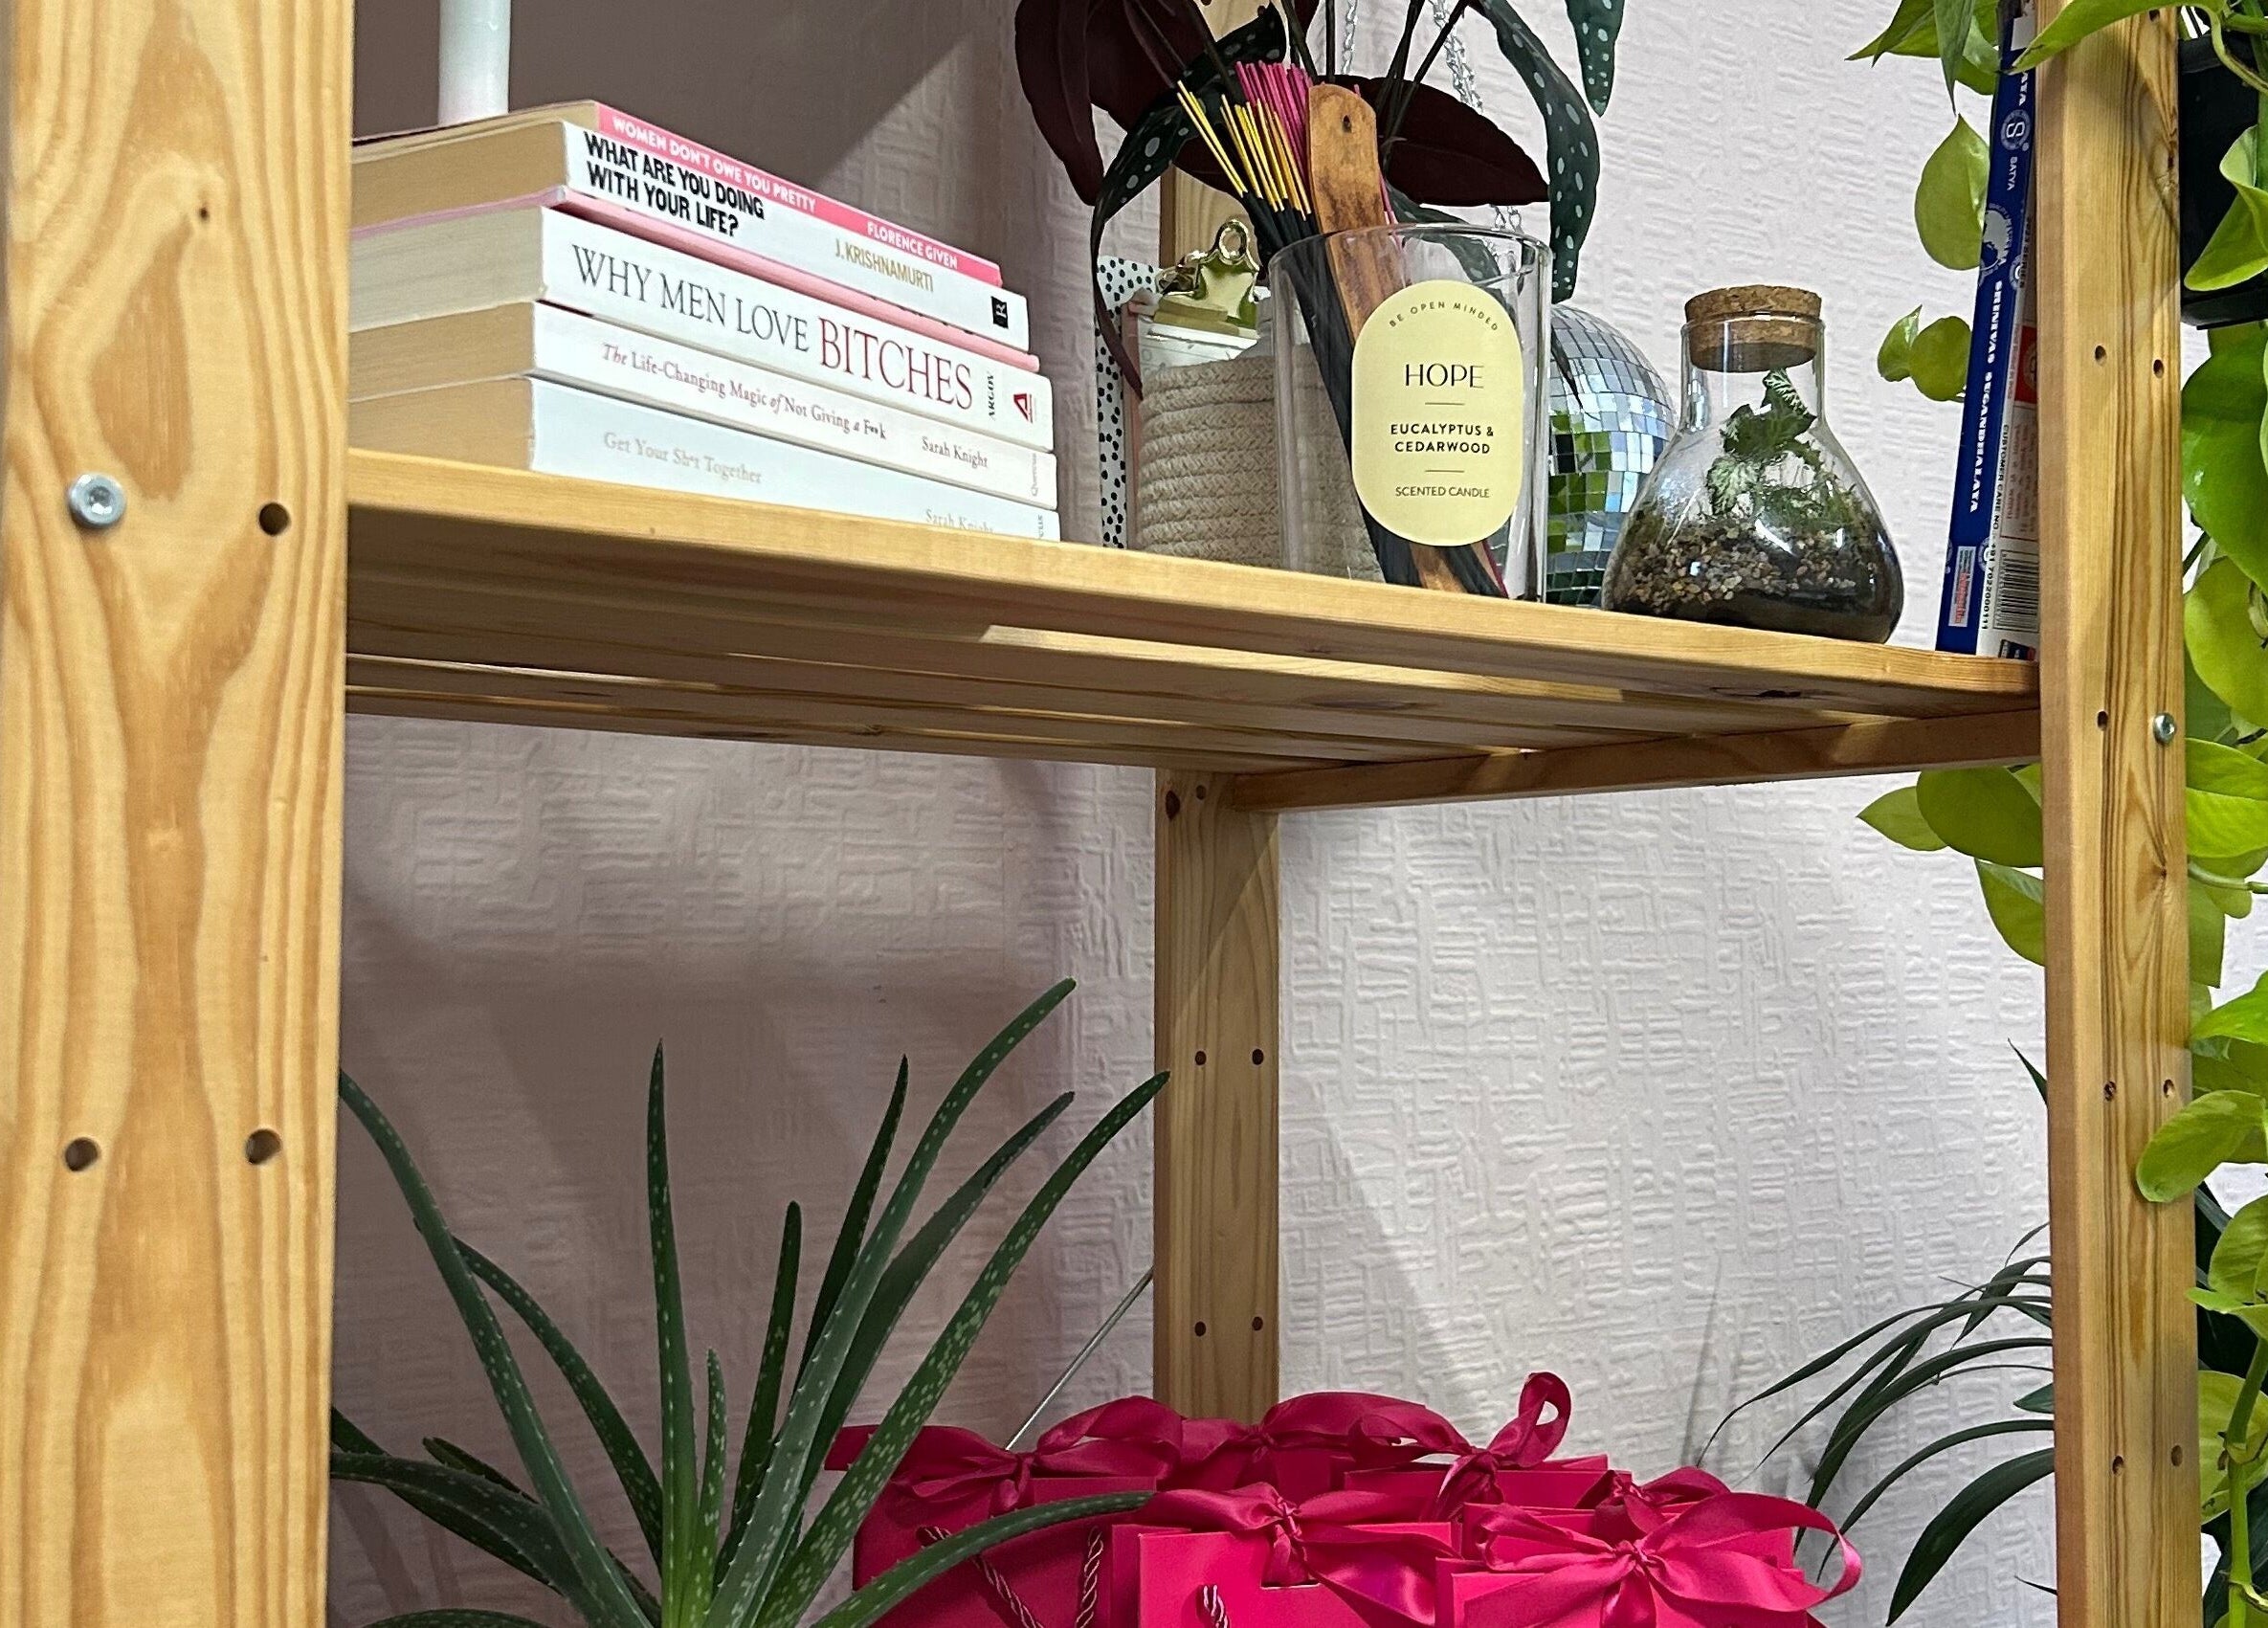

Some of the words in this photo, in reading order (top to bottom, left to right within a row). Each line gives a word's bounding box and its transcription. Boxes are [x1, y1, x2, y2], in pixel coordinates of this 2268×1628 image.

[584, 131, 638, 172] WHAT
[643, 153, 676, 188] ARE
[678, 167, 711, 199] YOU
[714, 181, 765, 220] DOING
[612, 116, 667, 150] WOMEN
[669, 141, 711, 168] DON'T
[713, 155, 743, 182] OWE
[744, 167, 771, 194] YOU
[773, 183, 816, 215] PRETTY
[2007, 156, 2018, 190] SATYA
[587, 161, 638, 202] WITH
[644, 181, 691, 221] YOUR
[696, 205, 739, 237] LIFE?
[867, 222, 924, 256] FLORENCE
[924, 244, 958, 270] GIVEN
[572, 244, 652, 301] WHY
[659, 272, 726, 327] MEN
[736, 298, 809, 352] LOVE
[818, 317, 973, 411] BITCHES
[1390, 313, 1405, 328] BE
[1411, 301, 1445, 315] OPEN
[1453, 301, 1499, 331] MINDED
[1987, 280, 2003, 364] SRINIVAS
[603, 343, 627, 365] The
[632, 351, 726, 399] Life-Changing
[729, 379, 767, 408] Magic
[770, 392, 783, 414] of
[785, 395, 808, 417] Not
[812, 405, 851, 434] Giving
[853, 421, 860, 432] a
[1405, 363, 1484, 390] HOPE
[922, 435, 950, 458] Sarah
[954, 444, 989, 469] Knight
[1390, 423, 1482, 436] EUCALYPTUS
[1486, 426, 1494, 436] &
[1394, 441, 1490, 455] CEDARWOOD
[1970, 371, 1993, 513] SUGANDHALAYA
[1997, 424, 2010, 480] CUSTOMER
[604, 432, 631, 453] Get
[634, 439, 668, 461] Your
[704, 456, 762, 484] Together
[1395, 486, 1446, 498] SCENTED
[1448, 486, 1490, 499] CANDLE
[1994, 483, 2004, 512] CARE
